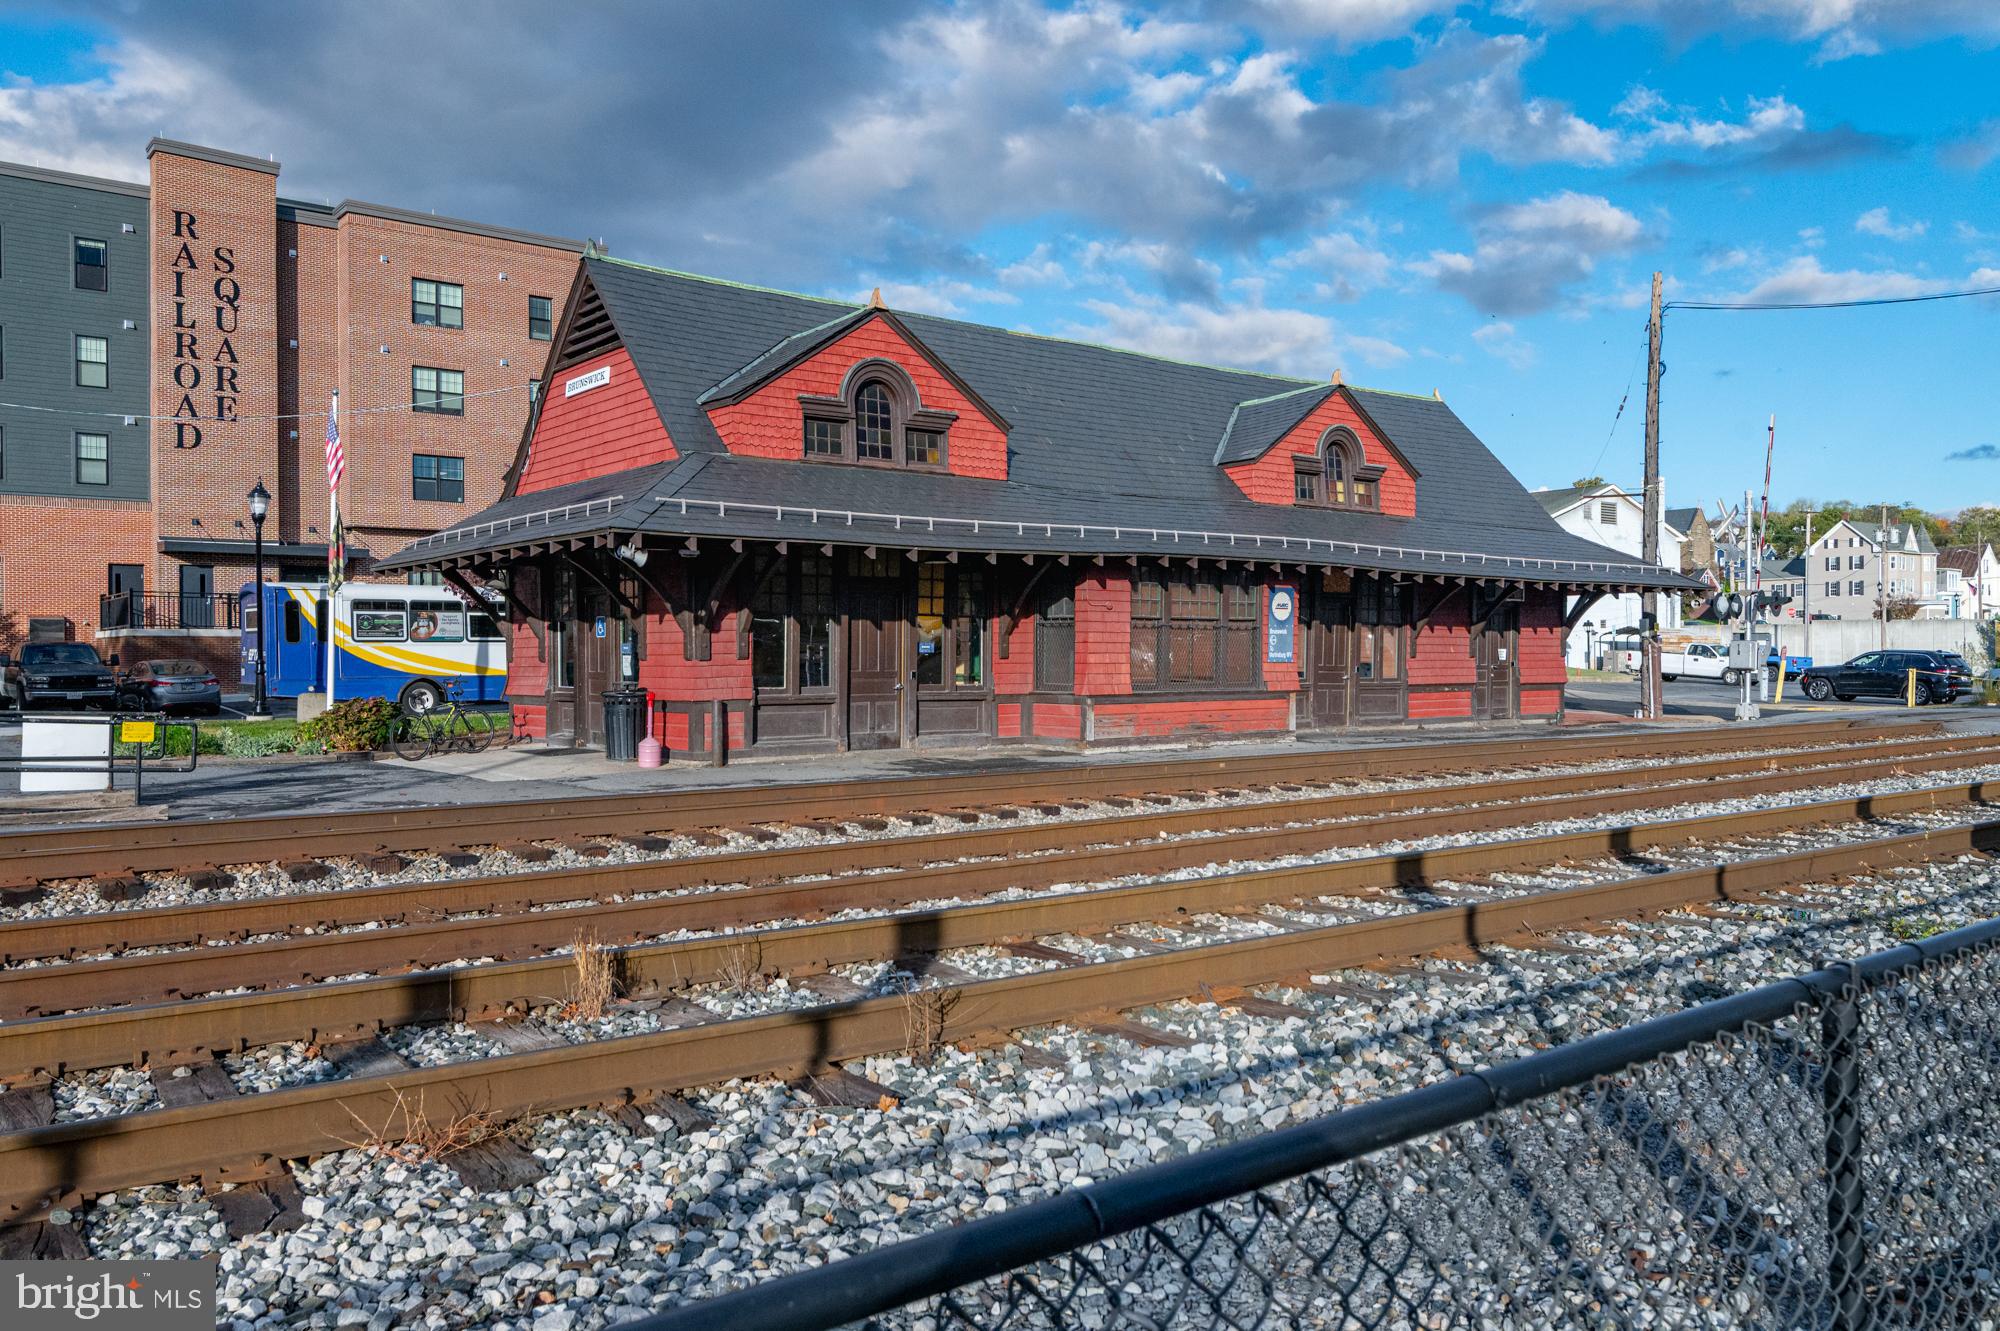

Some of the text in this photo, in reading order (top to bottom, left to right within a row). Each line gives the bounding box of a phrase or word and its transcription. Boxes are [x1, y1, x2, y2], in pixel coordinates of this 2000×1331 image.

[171, 209, 202, 449] RAILROAD
[213, 247, 241, 422] SQUARE
[567, 371, 606, 392] BRUNSWICK
